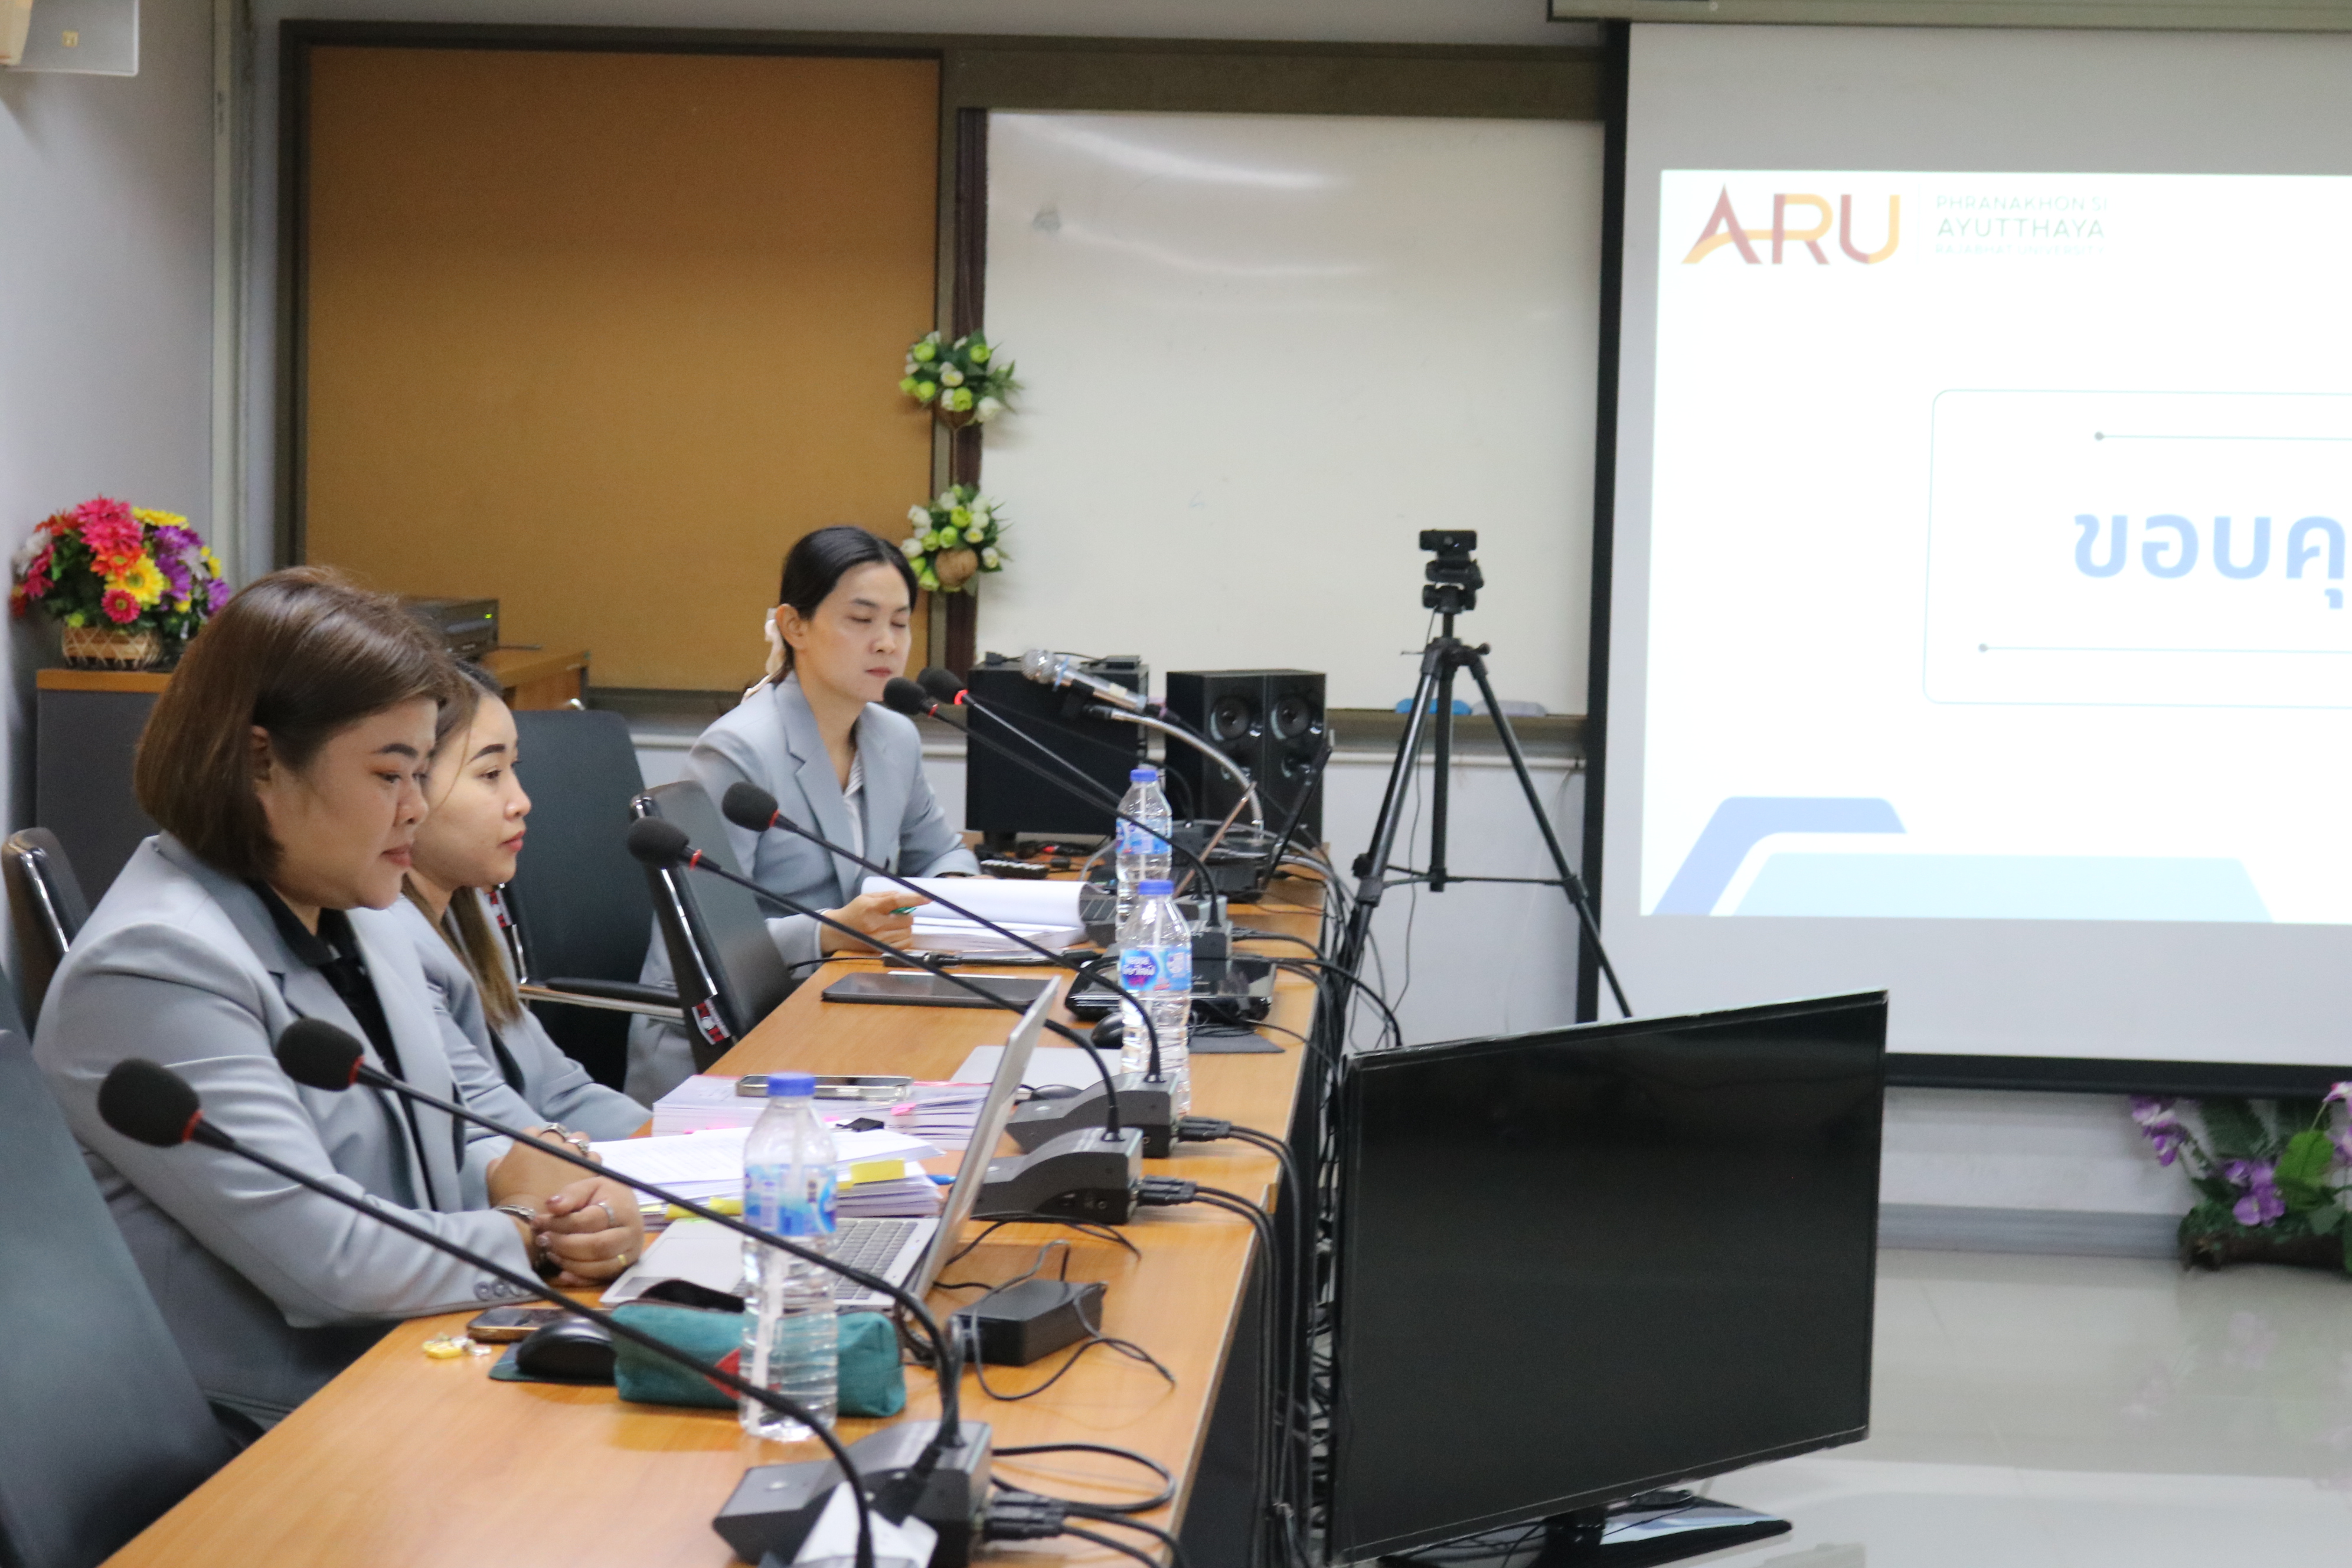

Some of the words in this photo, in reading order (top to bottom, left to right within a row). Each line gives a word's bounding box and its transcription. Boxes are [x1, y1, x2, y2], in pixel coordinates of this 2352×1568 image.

[1936, 194, 2085, 211] PHRANAKHON
[2092, 196, 2108, 211] SI
[1681, 184, 1901, 266] ARU
[1936, 217, 2106, 239] AYUTTHAYA
